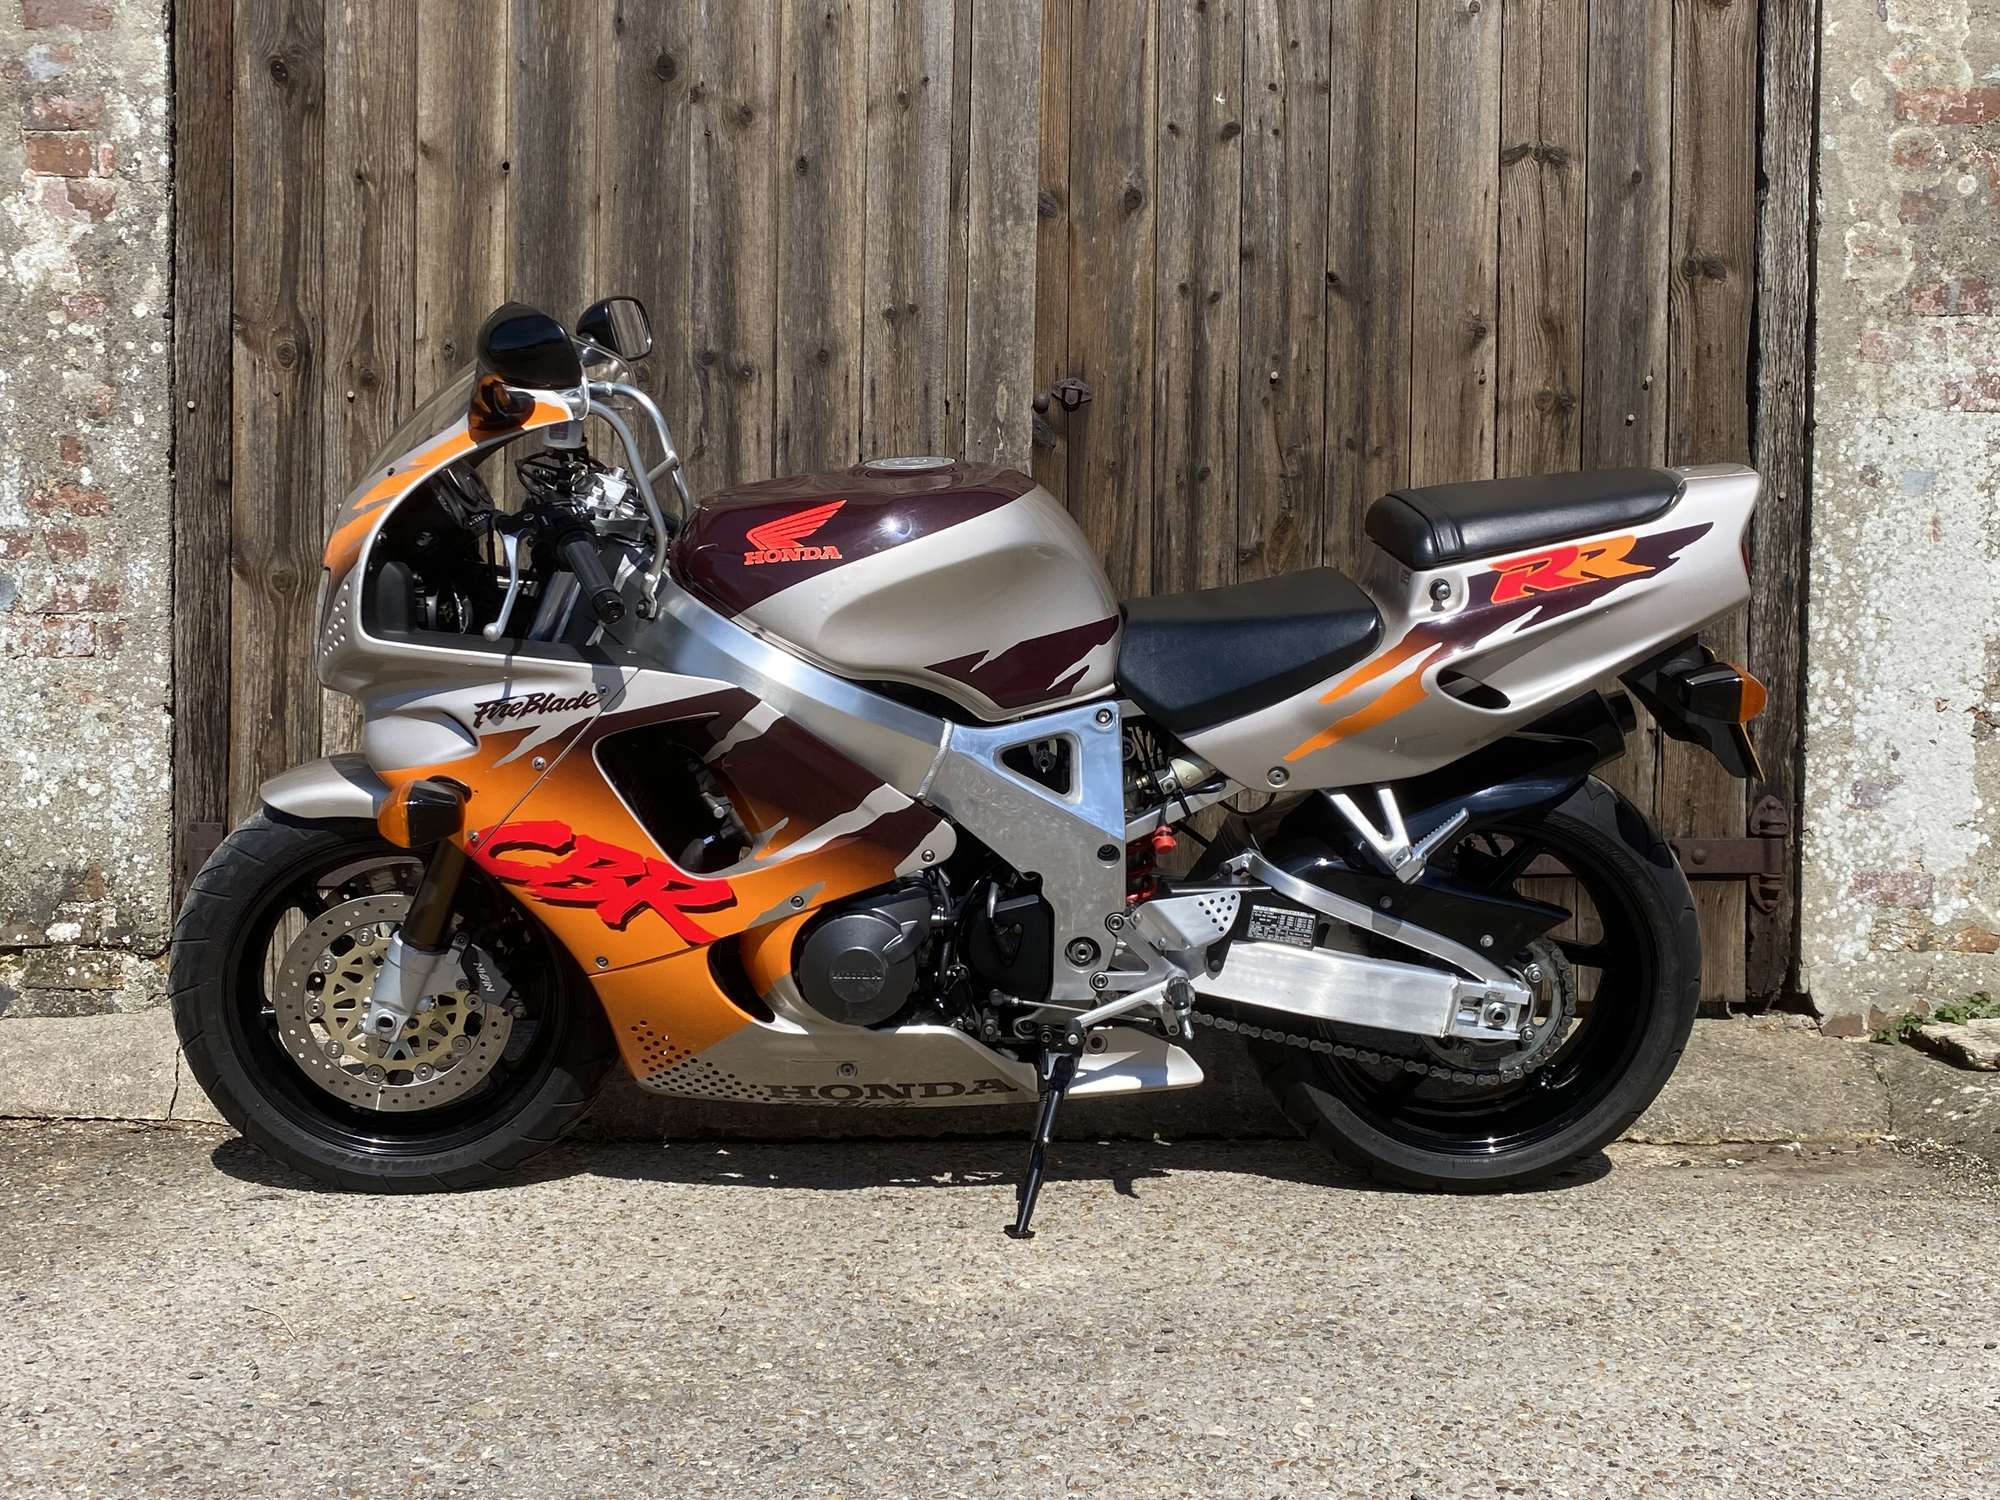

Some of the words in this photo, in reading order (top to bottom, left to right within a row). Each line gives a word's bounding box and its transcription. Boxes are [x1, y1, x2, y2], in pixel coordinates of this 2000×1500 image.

[744, 546, 842, 565] HONDA
[1488, 534, 1656, 604] RR
[473, 690, 601, 729] FireBlade
[466, 820, 737, 945] CBR
[763, 1078, 1018, 1100] HONDA
